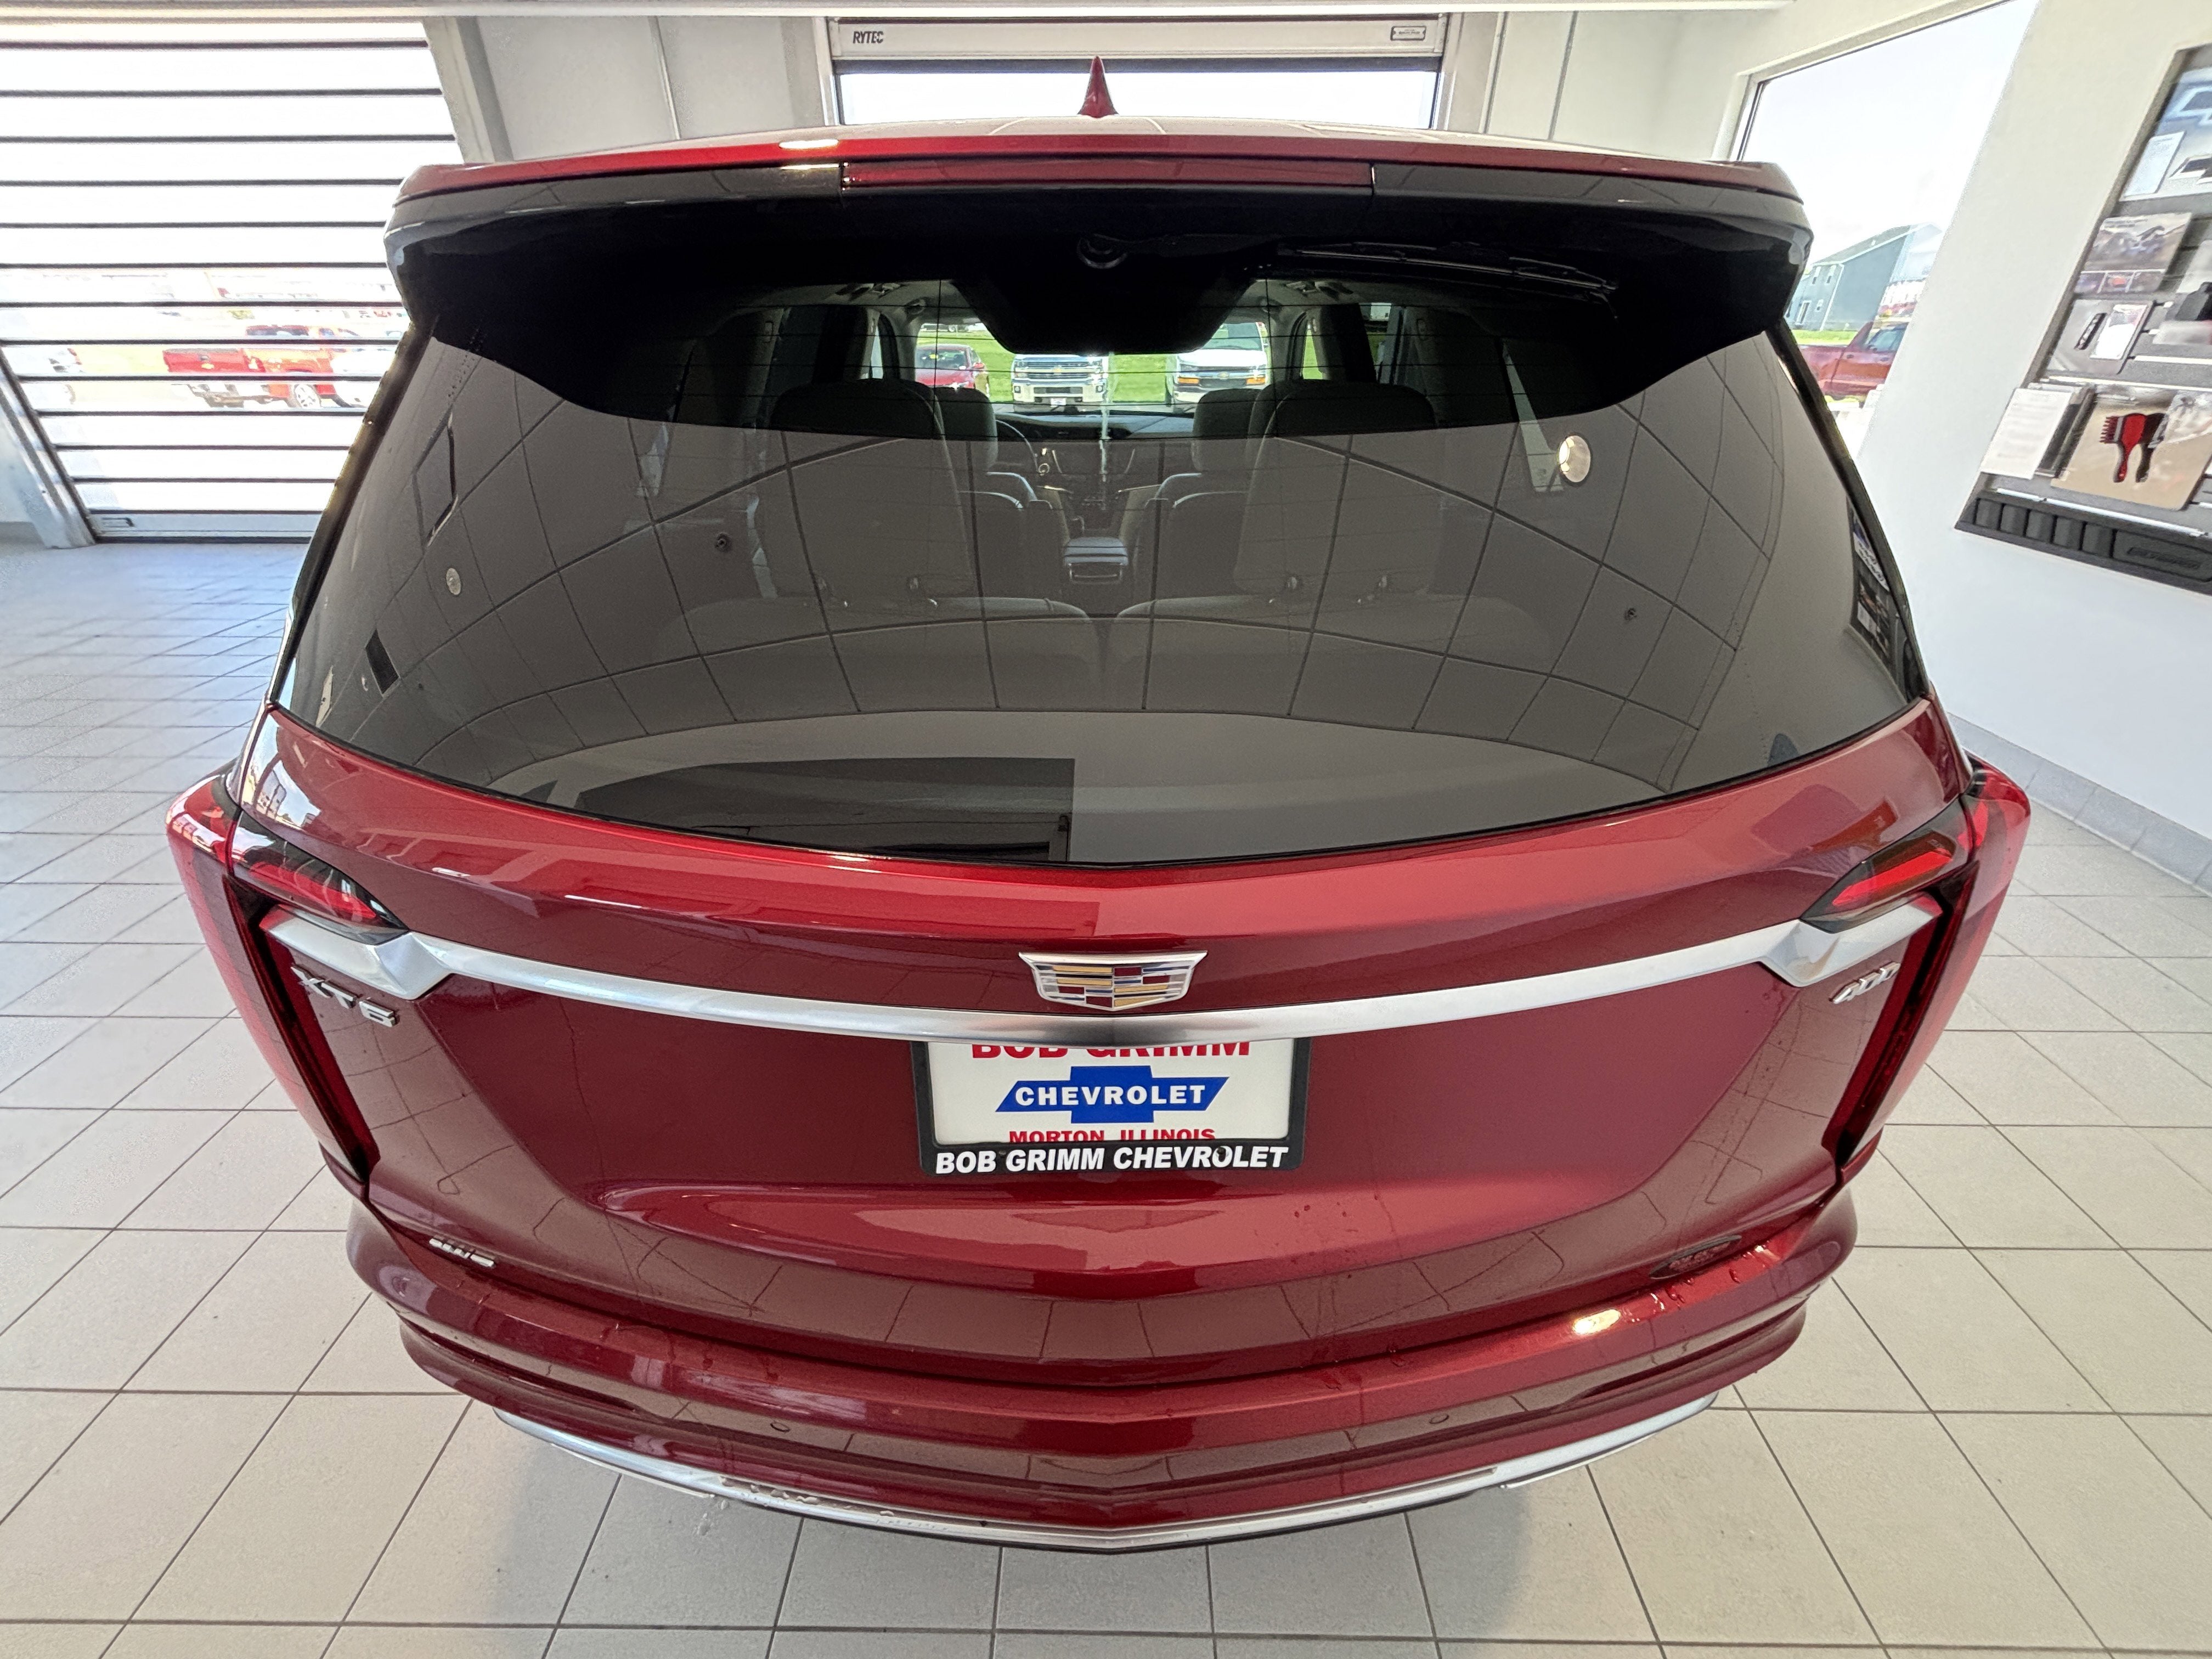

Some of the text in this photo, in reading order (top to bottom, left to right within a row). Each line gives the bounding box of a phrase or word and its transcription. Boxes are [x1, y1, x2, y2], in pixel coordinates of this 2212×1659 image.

[853, 30, 884, 44] RYTEC
[290, 966, 396, 1028] XT6
[1015, 1085, 1206, 1106] CHEVROLET
[1009, 1130, 1105, 1143] MORTON
[936, 1146, 1289, 1174] BOB GRIMM CHEVROLET
